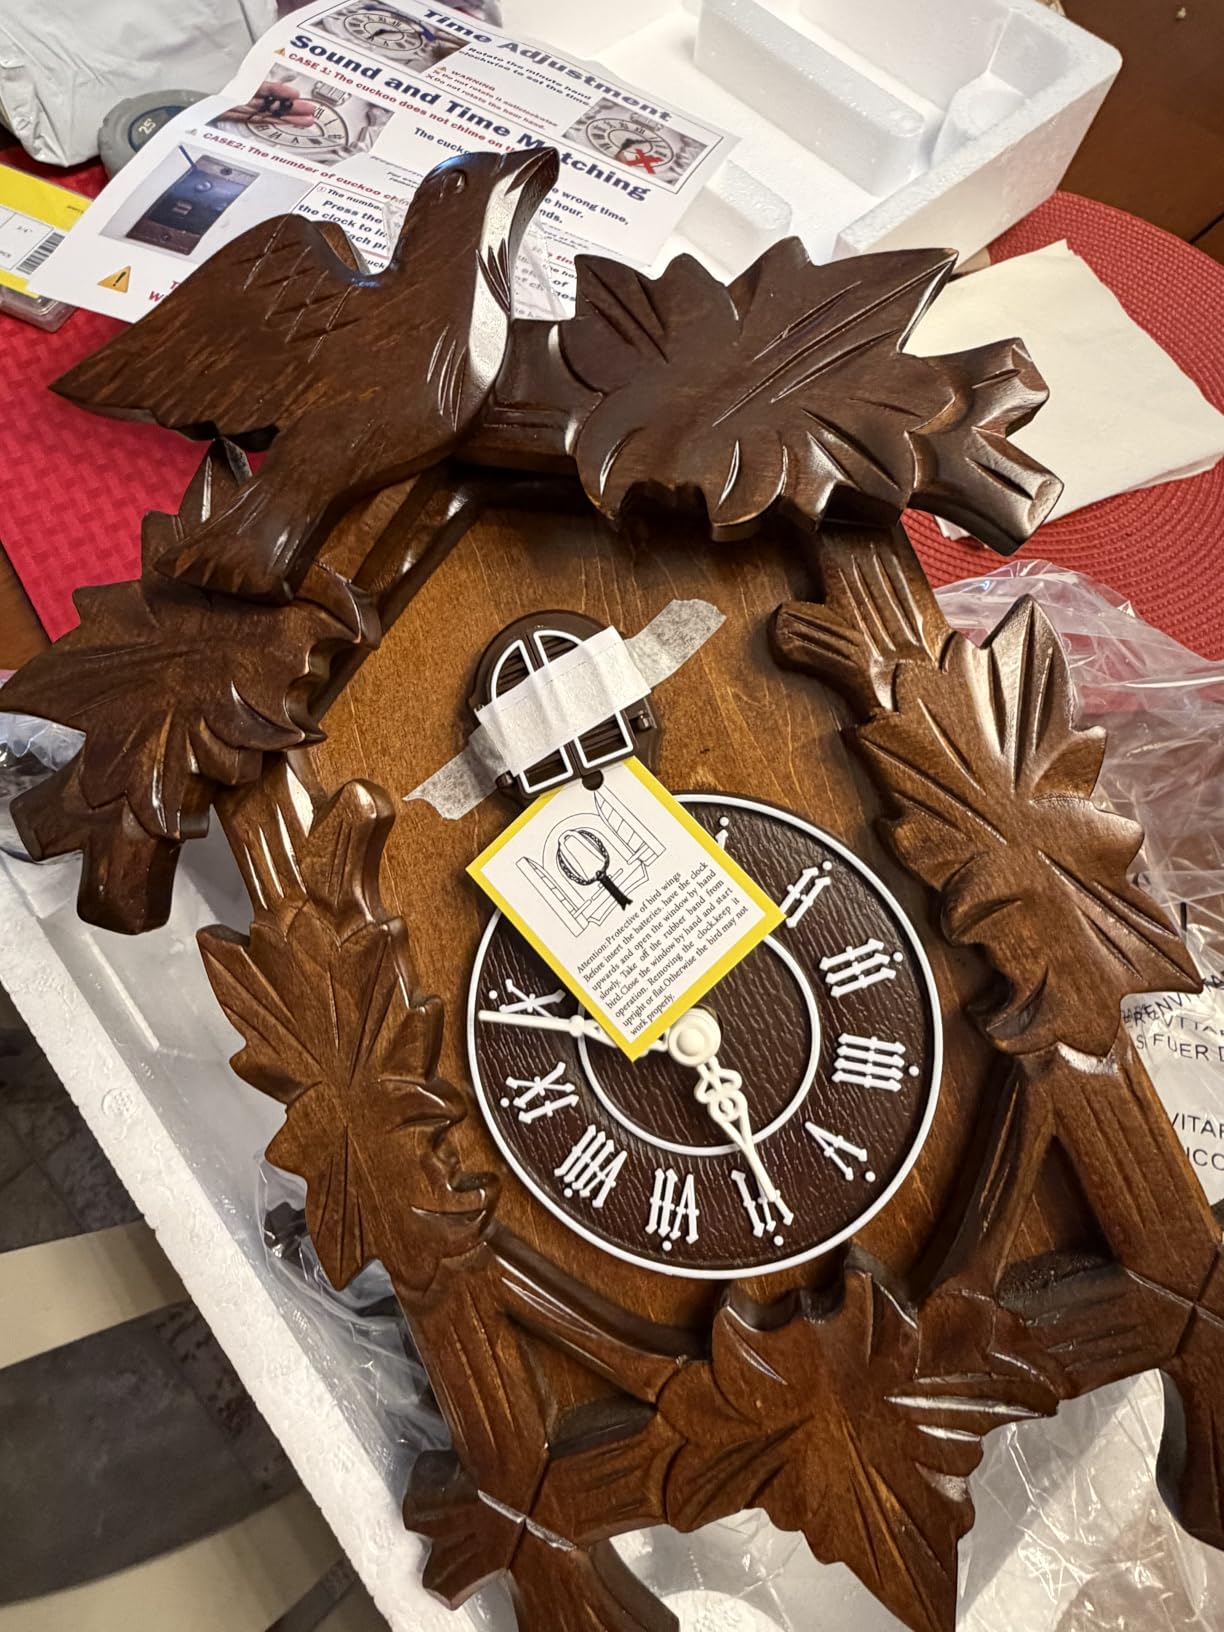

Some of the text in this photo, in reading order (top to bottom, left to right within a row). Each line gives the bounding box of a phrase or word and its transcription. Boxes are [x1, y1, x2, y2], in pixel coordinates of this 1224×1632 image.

[424, 9, 673, 123] Time Adjustment
[451, 70, 496, 92] WARNING
[288, 52, 321, 71] CASE
[333, 71, 354, 86] The
[356, 82, 397, 104] cuckoo
[399, 100, 427, 116] does
[429, 113, 449, 126] not
[450, 121, 487, 141] chime
[488, 138, 503, 149] on
[290, 34, 652, 203] Sound and Time Mtching
[414, 127, 434, 141] The
[203, 132, 246, 153] CASE2:
[248, 146, 270, 159] The
[271, 155, 320, 174] number
[320, 170, 336, 180] of
[336, 175, 382, 197] cuckoo
[321, 200, 383, 224] Press the
[327, 188, 344, 198] The
[554, 200, 584, 219] hour.
[562, 191, 600, 213] wrong
[298, 204, 320, 216] the
[321, 213, 358, 229] clock
[359, 225, 373, 233] to
[639, 901, 647, 912] of
[645, 888, 661, 904] bird
[661, 872, 680, 890] wings
[583, 962, 604, 982] Before
[604, 944, 622, 962] insert
[622, 933, 634, 944] the
[661, 890, 678, 906] have
[677, 879, 690, 890] the
[690, 862, 707, 879] clock
[591, 869, 716, 991] upwards and open the window by hand
[619, 962, 637, 977] Take
[639, 948, 649, 961] off
[649, 939, 661, 951] the
[663, 915, 685, 938] rubber
[685, 895, 705, 915] band
[705, 880, 724, 896] from
[638, 966, 650, 977] the
[650, 943, 675, 966] window
[672, 935, 684, 943] by
[682, 915, 702, 935] hand
[702, 902, 715, 917] and
[715, 887, 732, 904] start
[622, 1003, 646, 1026] upright
[645, 996, 653, 1004] or
[695, 944, 707, 956] the
[706, 928, 722, 945] bird
[721, 917, 736, 932] may
[735, 905, 748, 918] not
[647, 952, 683, 985] Removing
[681, 941, 694, 952] the
[630, 1018, 647, 1034] work
